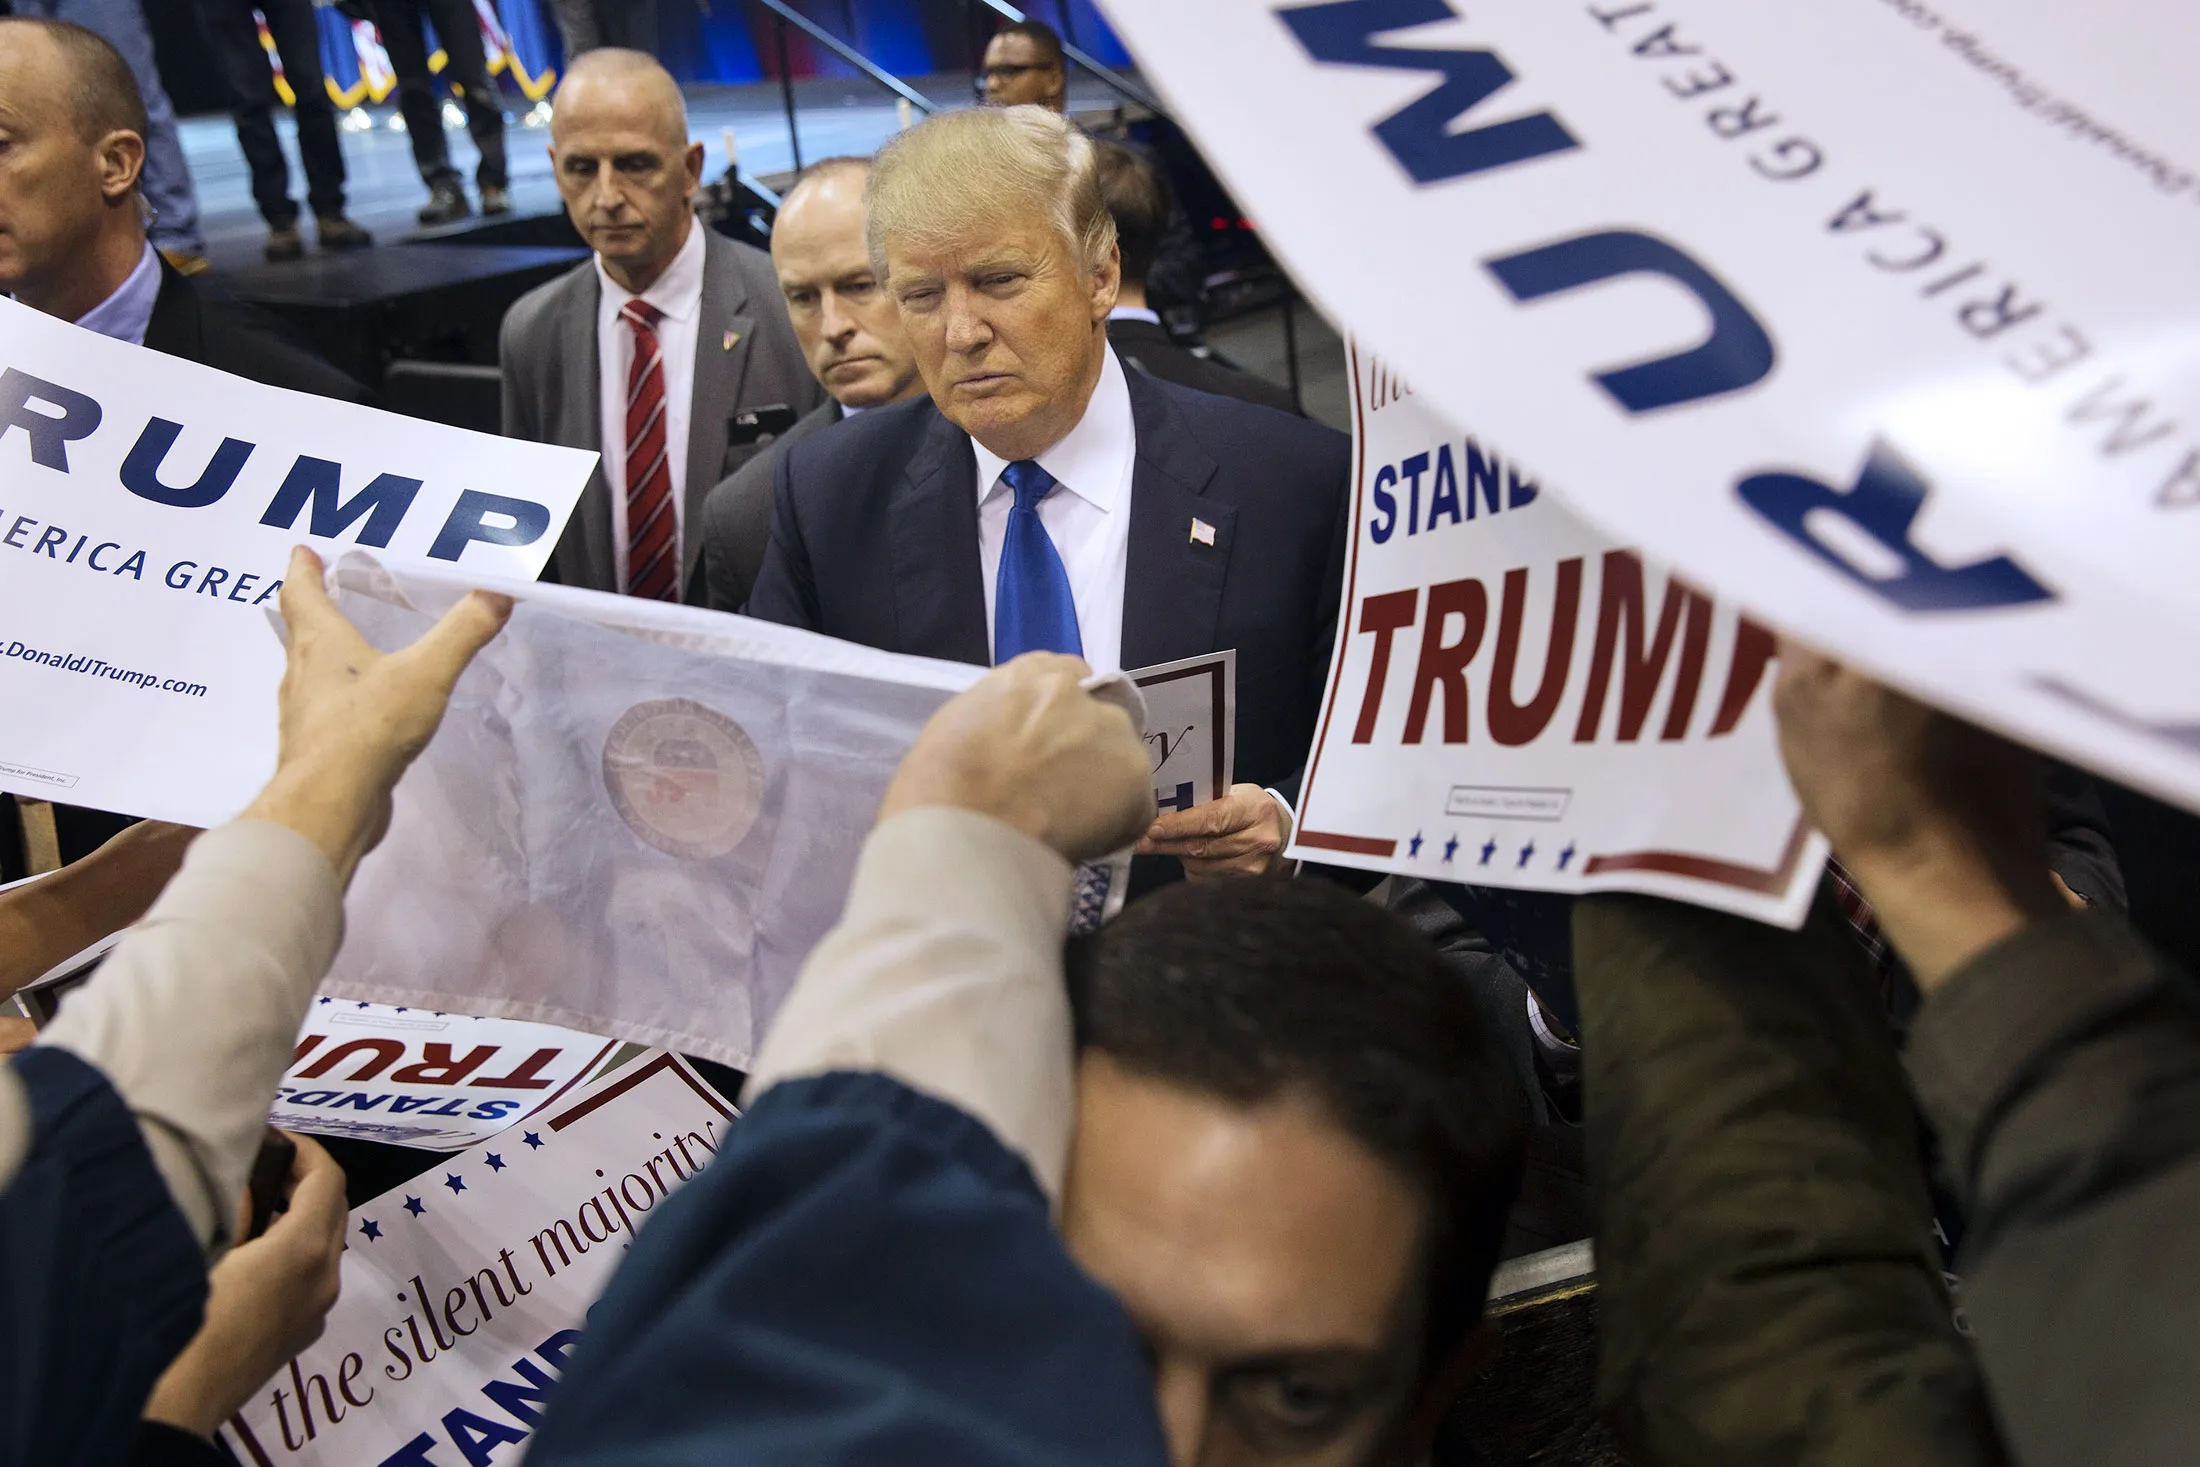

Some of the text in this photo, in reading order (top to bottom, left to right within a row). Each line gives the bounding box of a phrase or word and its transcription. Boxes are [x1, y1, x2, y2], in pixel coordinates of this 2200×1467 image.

[1586, 0, 1824, 181] GREAT
[1272, 0, 2200, 745] RUM
[0, 367, 551, 562] RUMP
[0, 508, 147, 580] ERICA
[0, 641, 208, 697] .DonaldJTrump.com
[284, 1035, 564, 1090] TRU
[271, 1120, 720, 1452] the silent majority
